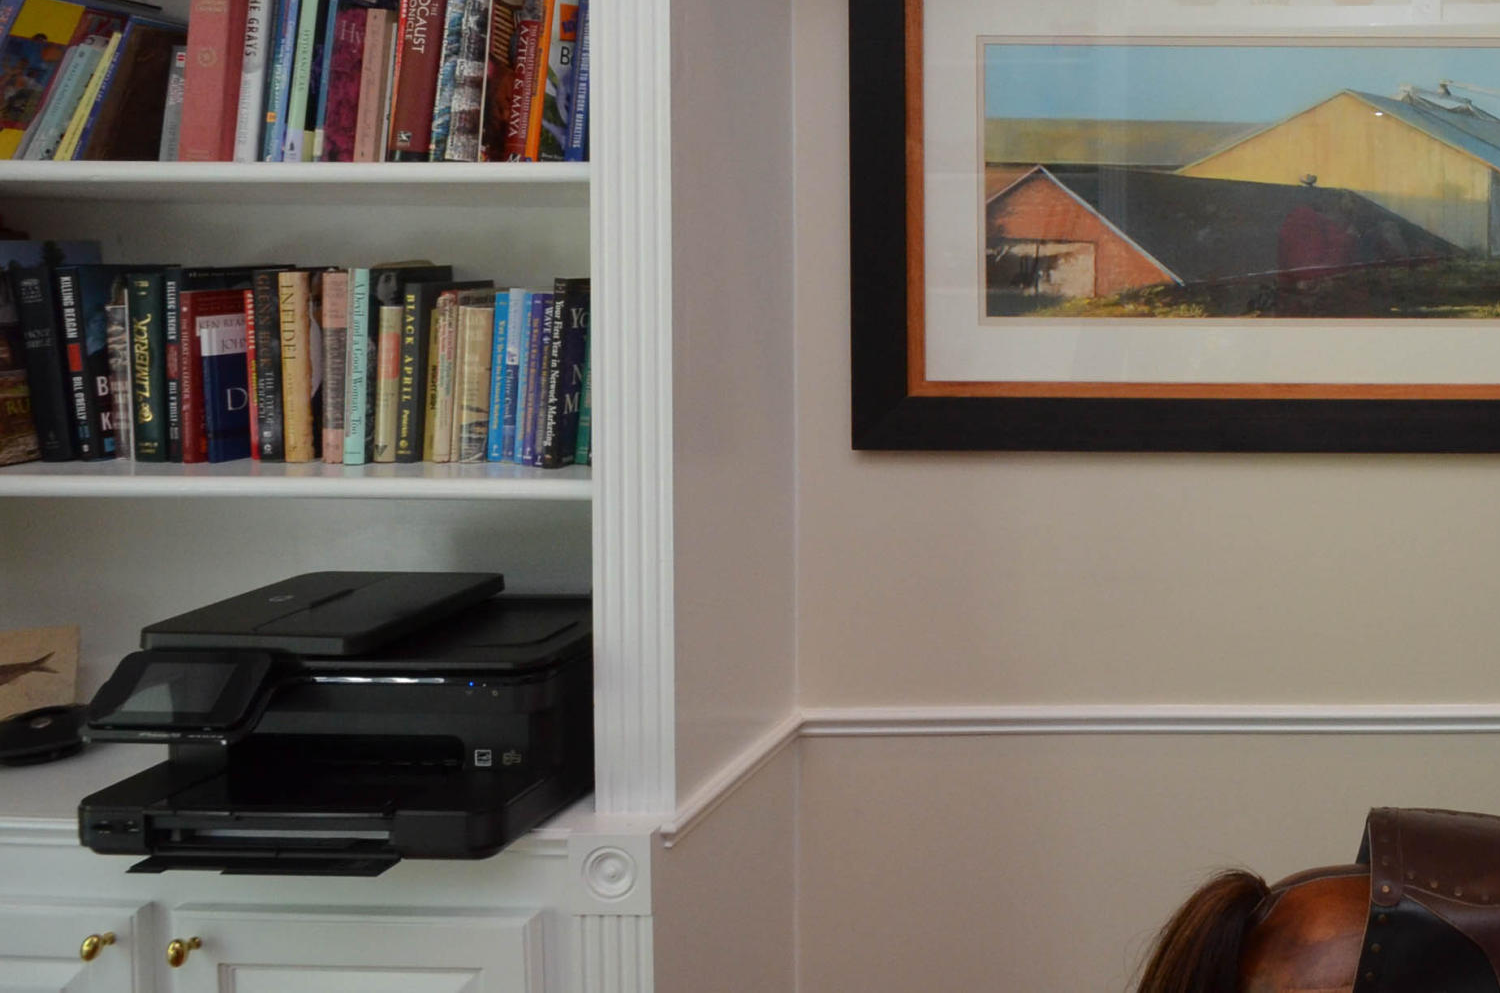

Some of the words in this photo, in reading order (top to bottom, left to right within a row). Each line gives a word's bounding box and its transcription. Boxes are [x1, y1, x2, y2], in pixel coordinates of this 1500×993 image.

[430, 2, 439, 17] THE
[244, 17, 260, 58] GRAYS
[514, 25, 530, 72] AZTEC
[512, 78, 523, 91] &
[507, 93, 521, 138] MAYA
[60, 276, 75, 307] KILLING
[167, 280, 179, 310] KILLING
[353, 292, 366, 318] Devil
[63, 308, 79, 339] REAGAN
[280, 284, 298, 362] INFIDEL
[404, 293, 417, 346] BLACK
[543, 306, 555, 334] WAVE
[554, 299, 566, 319] Your
[168, 311, 179, 341] LINCOLN
[353, 319, 363, 338] and
[552, 320, 564, 340] First
[133, 313, 153, 400] LIMERICK
[181, 331, 192, 356] HEART
[551, 340, 562, 358] Year
[353, 348, 364, 375] Good
[551, 359, 561, 368] in
[72, 375, 84, 392] BILL
[182, 372, 192, 400] LEADER
[401, 355, 414, 403] APRIL
[548, 369, 561, 404] Network
[543, 405, 558, 447] Marketing
